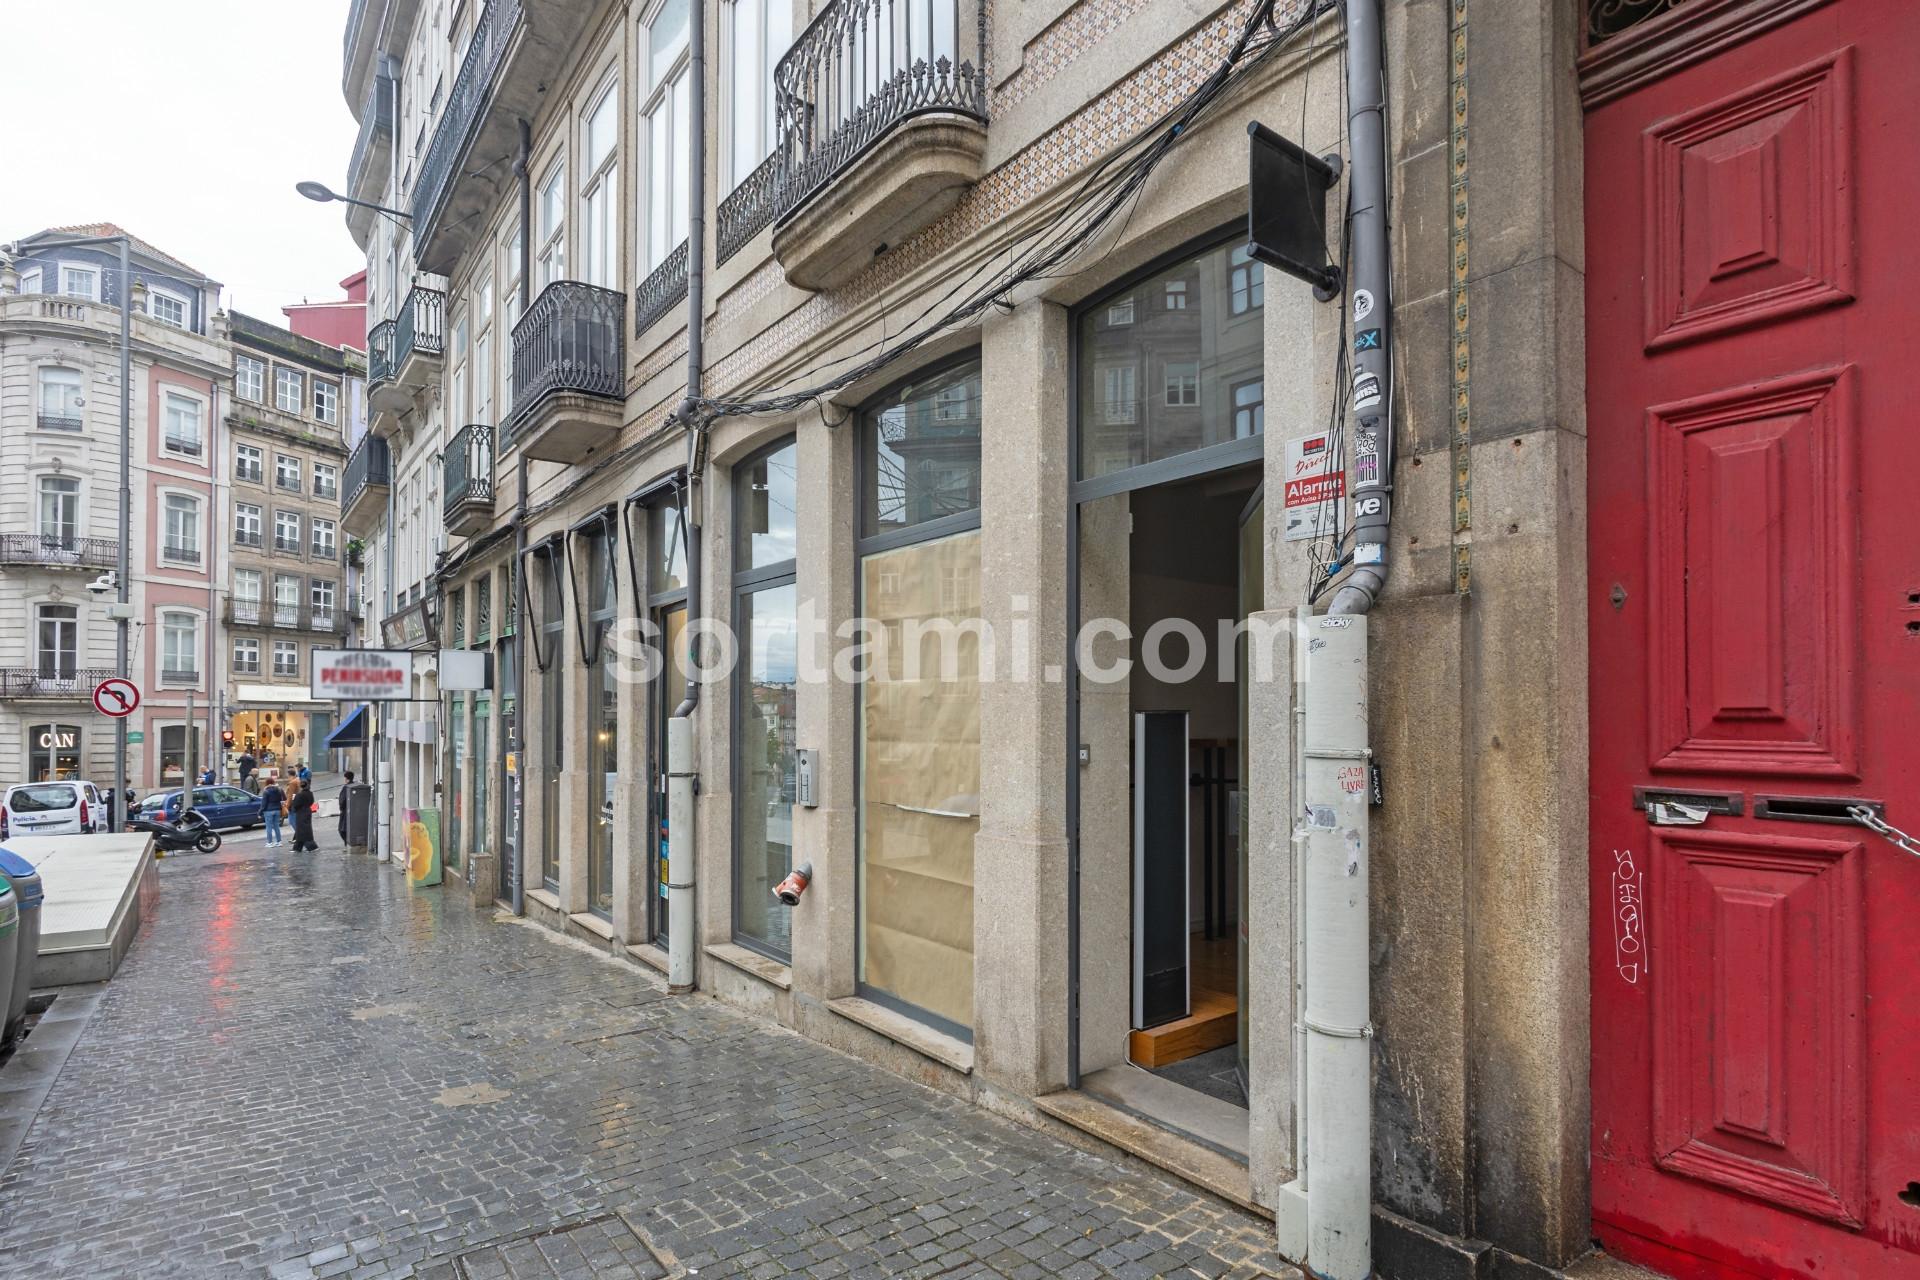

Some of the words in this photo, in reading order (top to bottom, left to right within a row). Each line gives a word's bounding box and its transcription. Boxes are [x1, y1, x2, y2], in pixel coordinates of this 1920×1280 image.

[1288, 478, 1342, 499] Alarme
[1301, 495, 1317, 504] Aviso
[1320, 617, 1352, 629] sticky
[1338, 767, 1364, 779] GAZA
[1341, 781, 1365, 791] LIVRE
